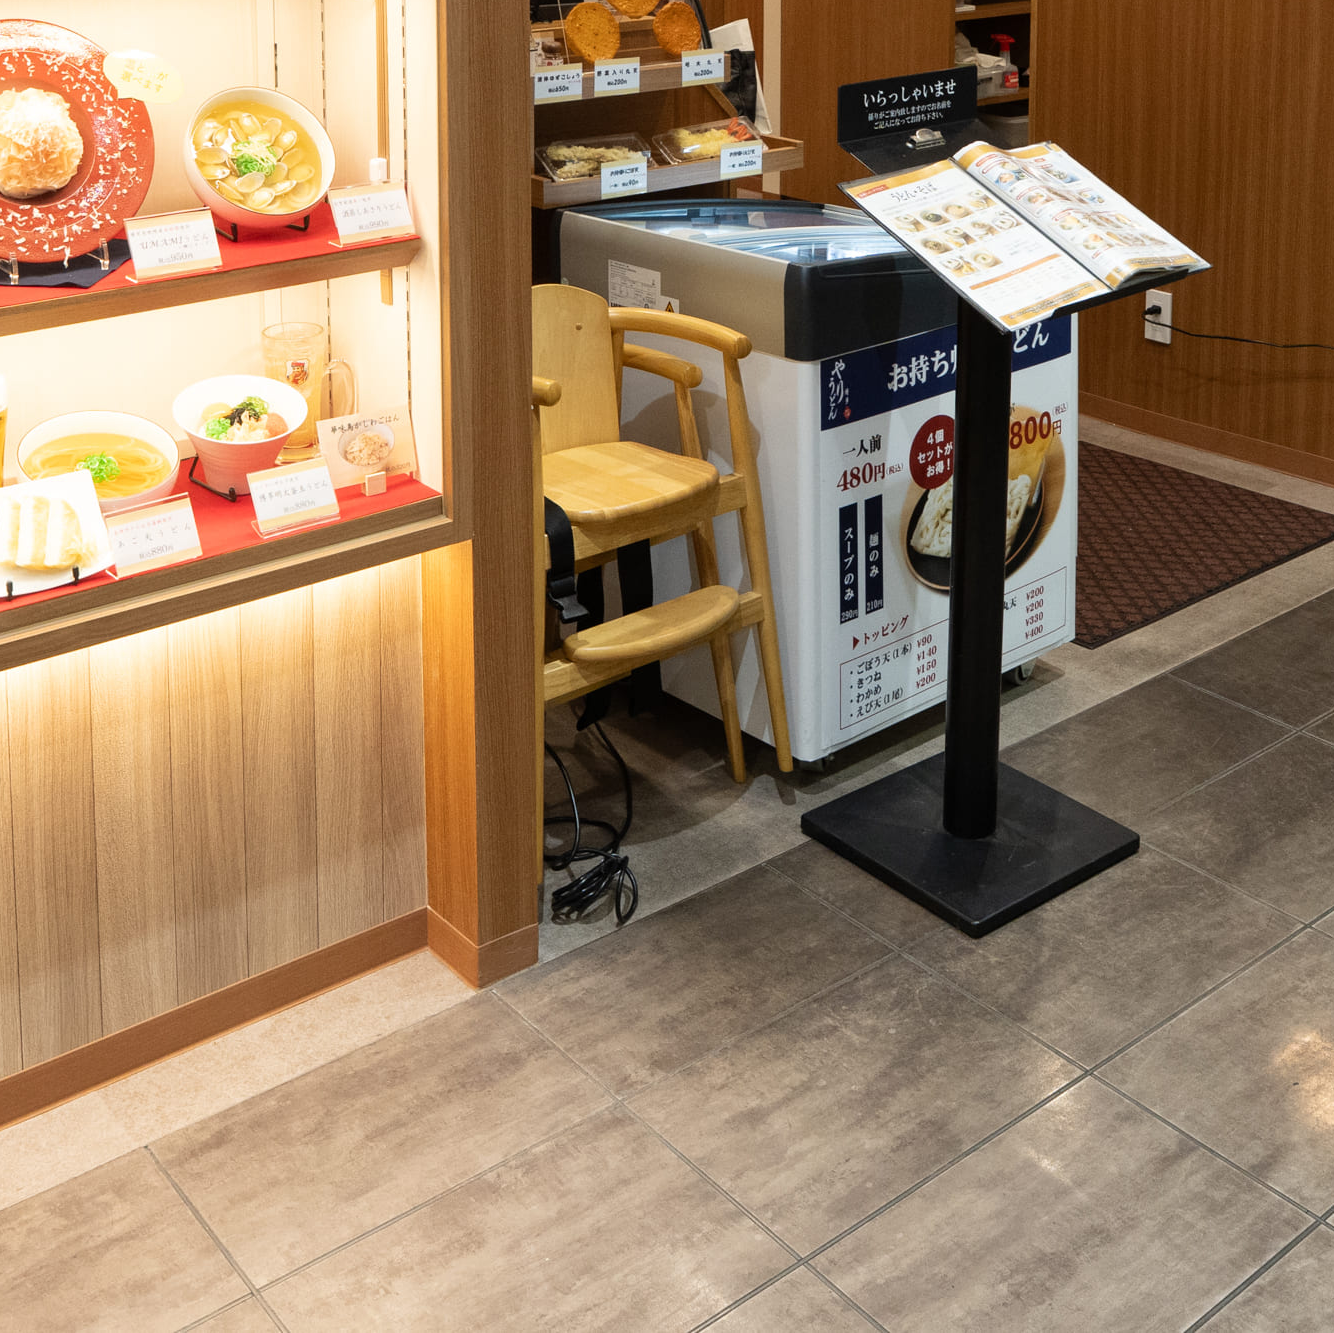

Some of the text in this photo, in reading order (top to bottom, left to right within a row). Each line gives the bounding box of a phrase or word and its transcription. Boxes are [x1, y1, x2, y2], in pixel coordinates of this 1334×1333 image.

[863, 78, 956, 108] いらっしゃいませ
[843, 433, 882, 458] 一人前
[927, 429, 945, 445] 4個
[917, 441, 953, 464] セットが
[836, 461, 886, 492] 480円
[843, 527, 855, 602] スープのみ
[869, 533, 879, 578] 麺のみ
[864, 615, 909, 645] トッピング
[917, 634, 933, 648] ¥90
[856, 671, 882, 689] きつね
[856, 684, 882, 704] わかめ
